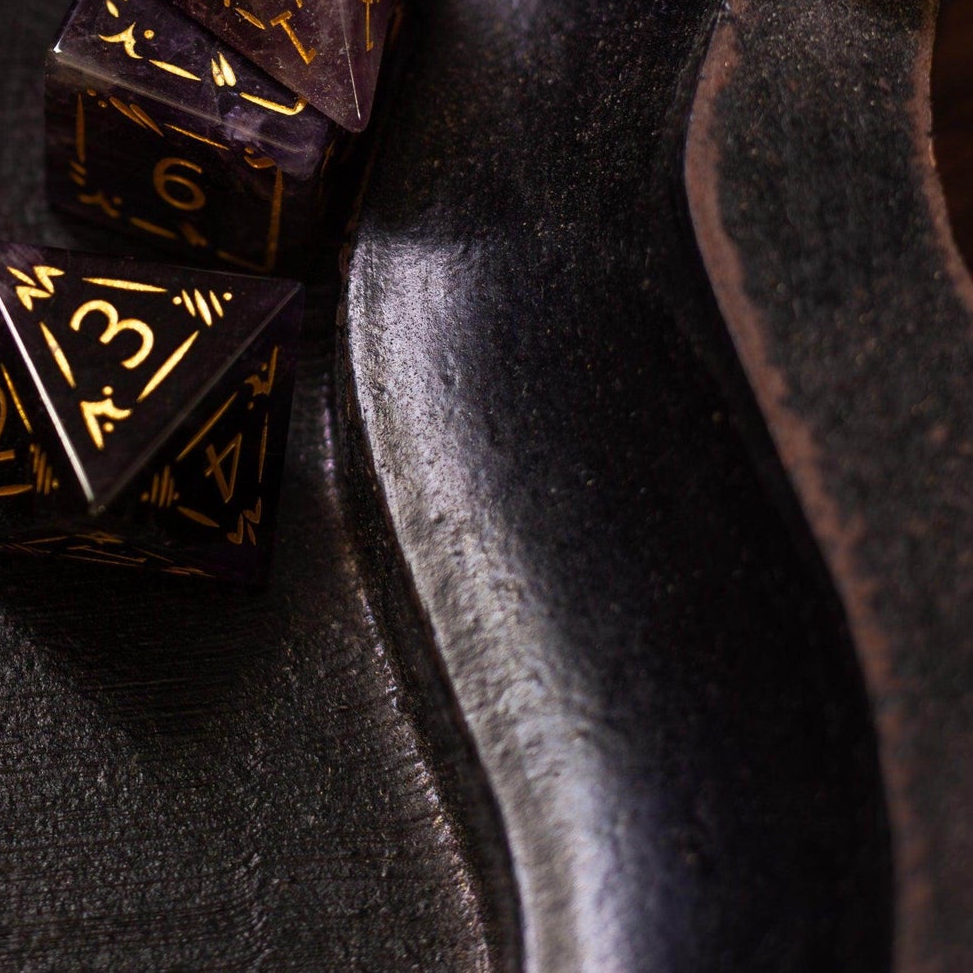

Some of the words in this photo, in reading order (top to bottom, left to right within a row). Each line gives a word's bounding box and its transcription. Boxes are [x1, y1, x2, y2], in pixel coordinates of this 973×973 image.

[270, 10, 316, 65] 1
[152, 156, 207, 211] 6
[69, 299, 155, 370] 3
[204, 432, 243, 504] 4
